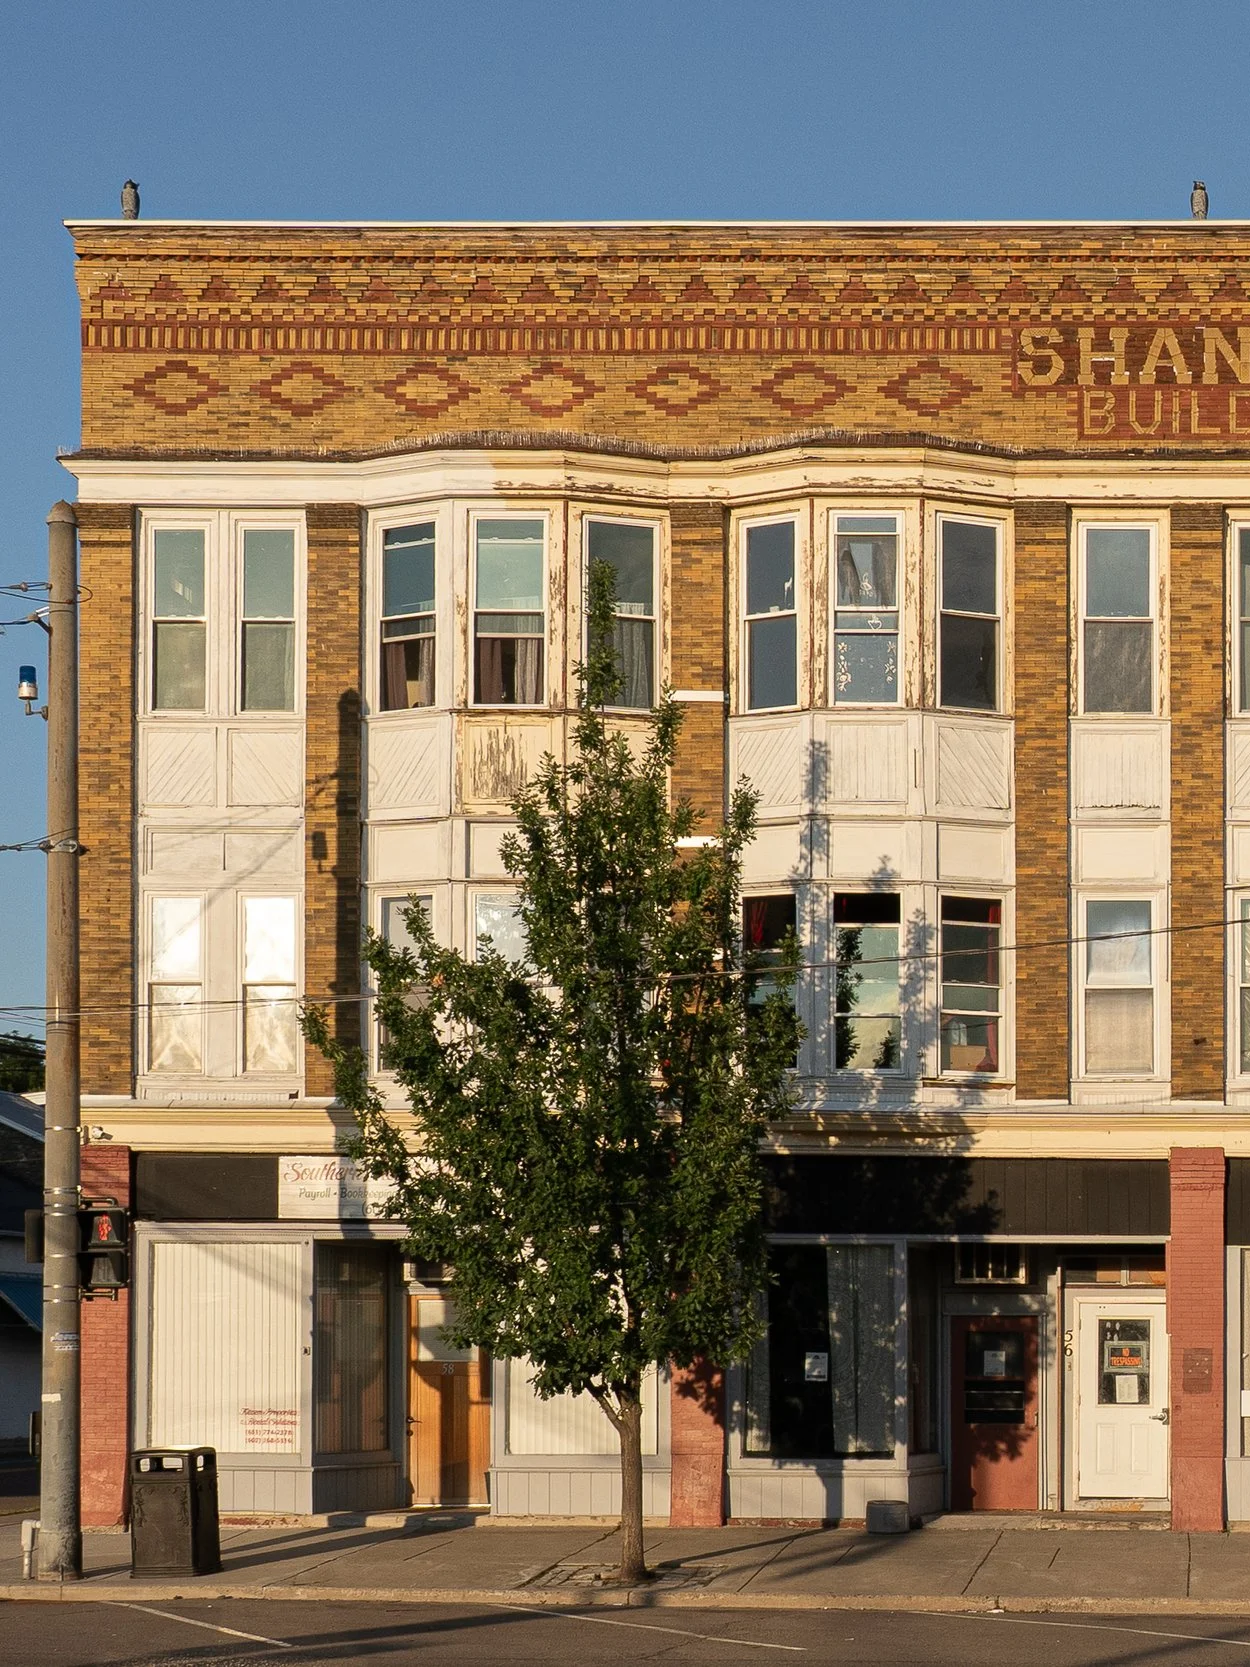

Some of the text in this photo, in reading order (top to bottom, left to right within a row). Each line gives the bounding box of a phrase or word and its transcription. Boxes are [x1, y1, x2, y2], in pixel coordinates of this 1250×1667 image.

[299, 1186, 331, 1200] Payroll
[1111, 1357, 1142, 1366] TRESPASSING
[442, 1363, 455, 1375] 58
